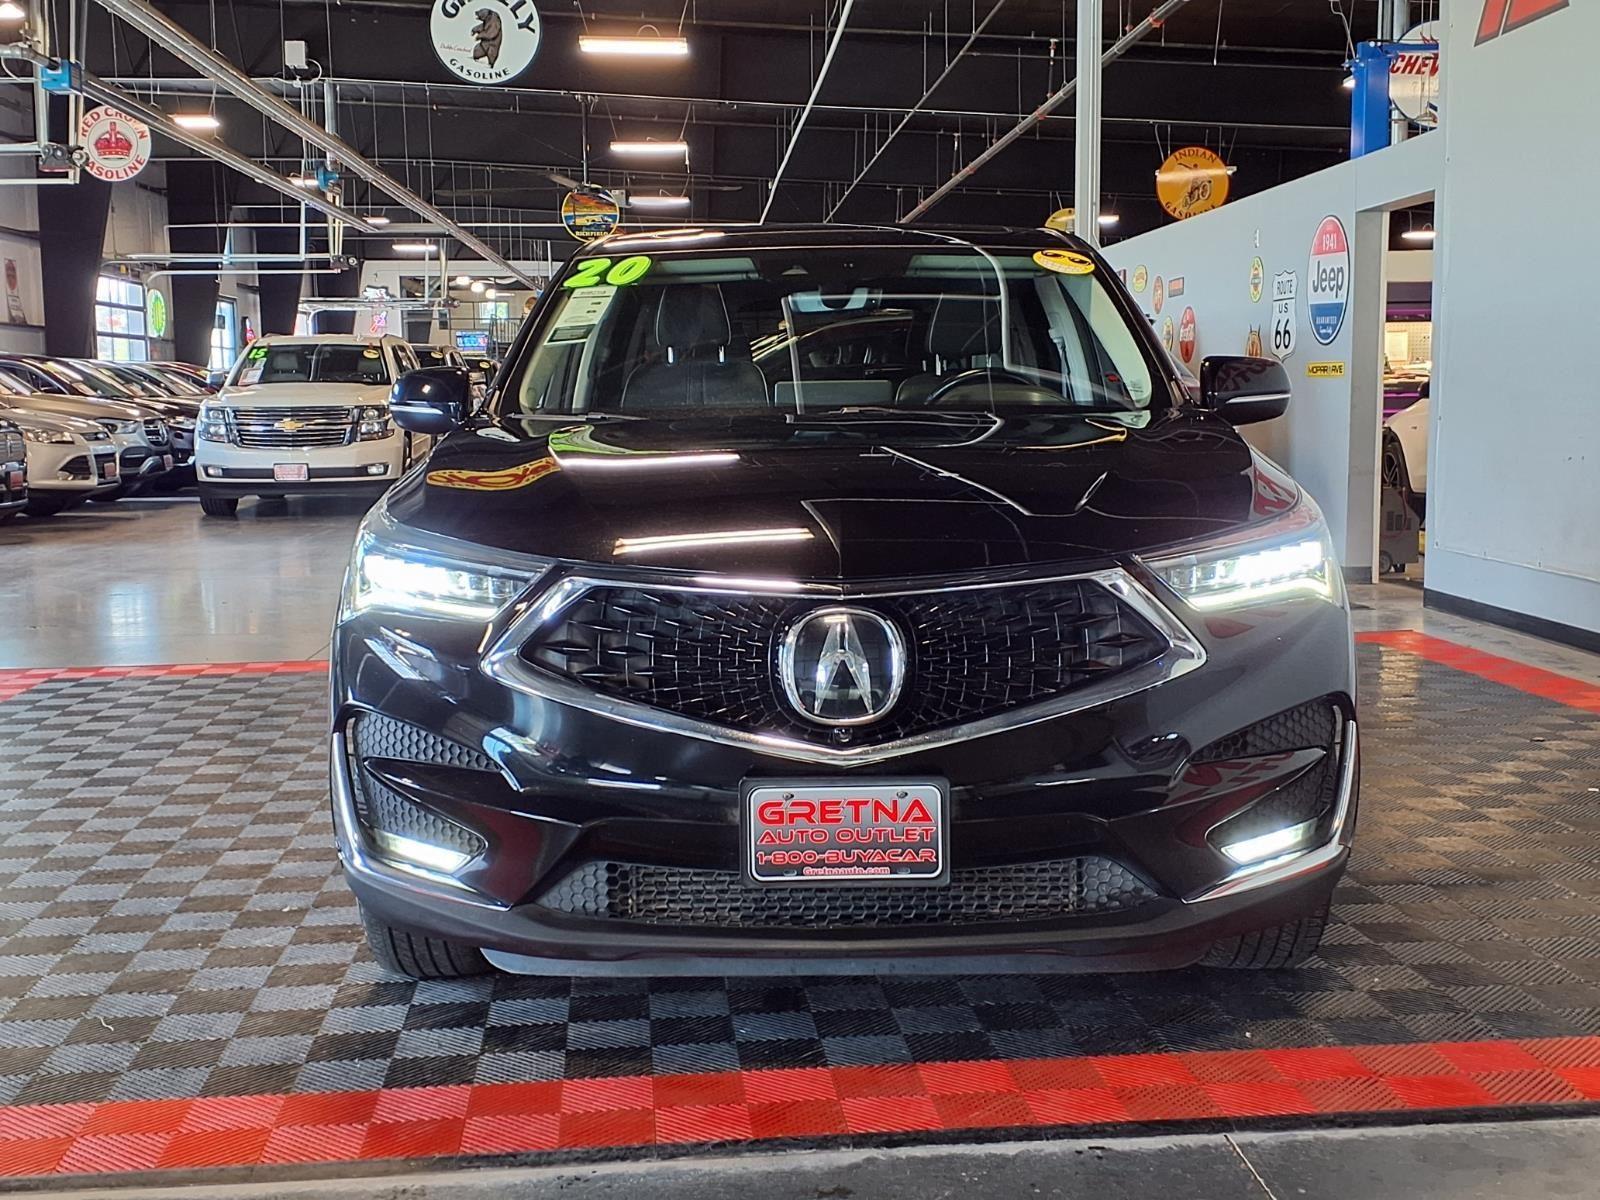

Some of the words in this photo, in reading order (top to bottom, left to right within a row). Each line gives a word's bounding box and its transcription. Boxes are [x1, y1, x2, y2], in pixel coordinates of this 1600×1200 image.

[449, 58, 511, 80] GASOLINE
[1173, 148, 1217, 164] INDIAN
[85, 154, 146, 179] ASOLINE
[1322, 232, 1338, 252] 1941
[562, 255, 652, 288] 20
[1312, 260, 1345, 298] Jeep
[1277, 279, 1293, 295] ROUTE
[1278, 302, 1289, 314] US
[1274, 318, 1291, 350] 66
[248, 348, 268, 359] 15
[756, 798, 936, 825] GRETNA
[758, 829, 829, 844] AUTO
[836, 827, 935, 843] OUTLET
[756, 849, 936, 865] 1-800-BUYACAR
[802, 866, 891, 875] Gretnaauto.com
